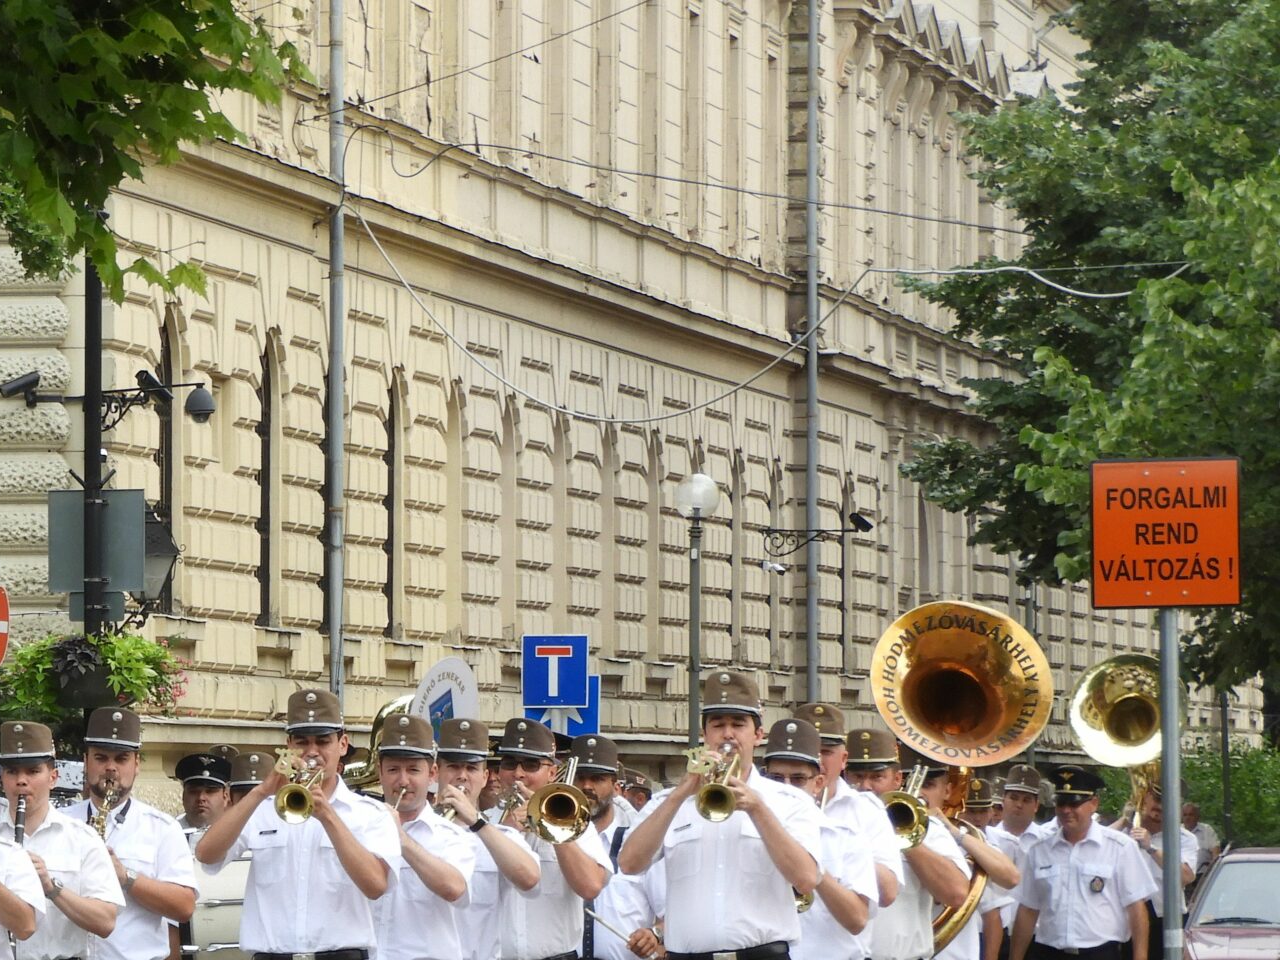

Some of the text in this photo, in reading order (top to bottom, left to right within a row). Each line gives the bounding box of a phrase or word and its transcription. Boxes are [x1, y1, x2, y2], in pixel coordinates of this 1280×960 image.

[1106, 486, 1227, 510] FORGALMI
[1135, 522, 1199, 545] REND
[1099, 553, 1220, 582] VÁLTOZÁS
